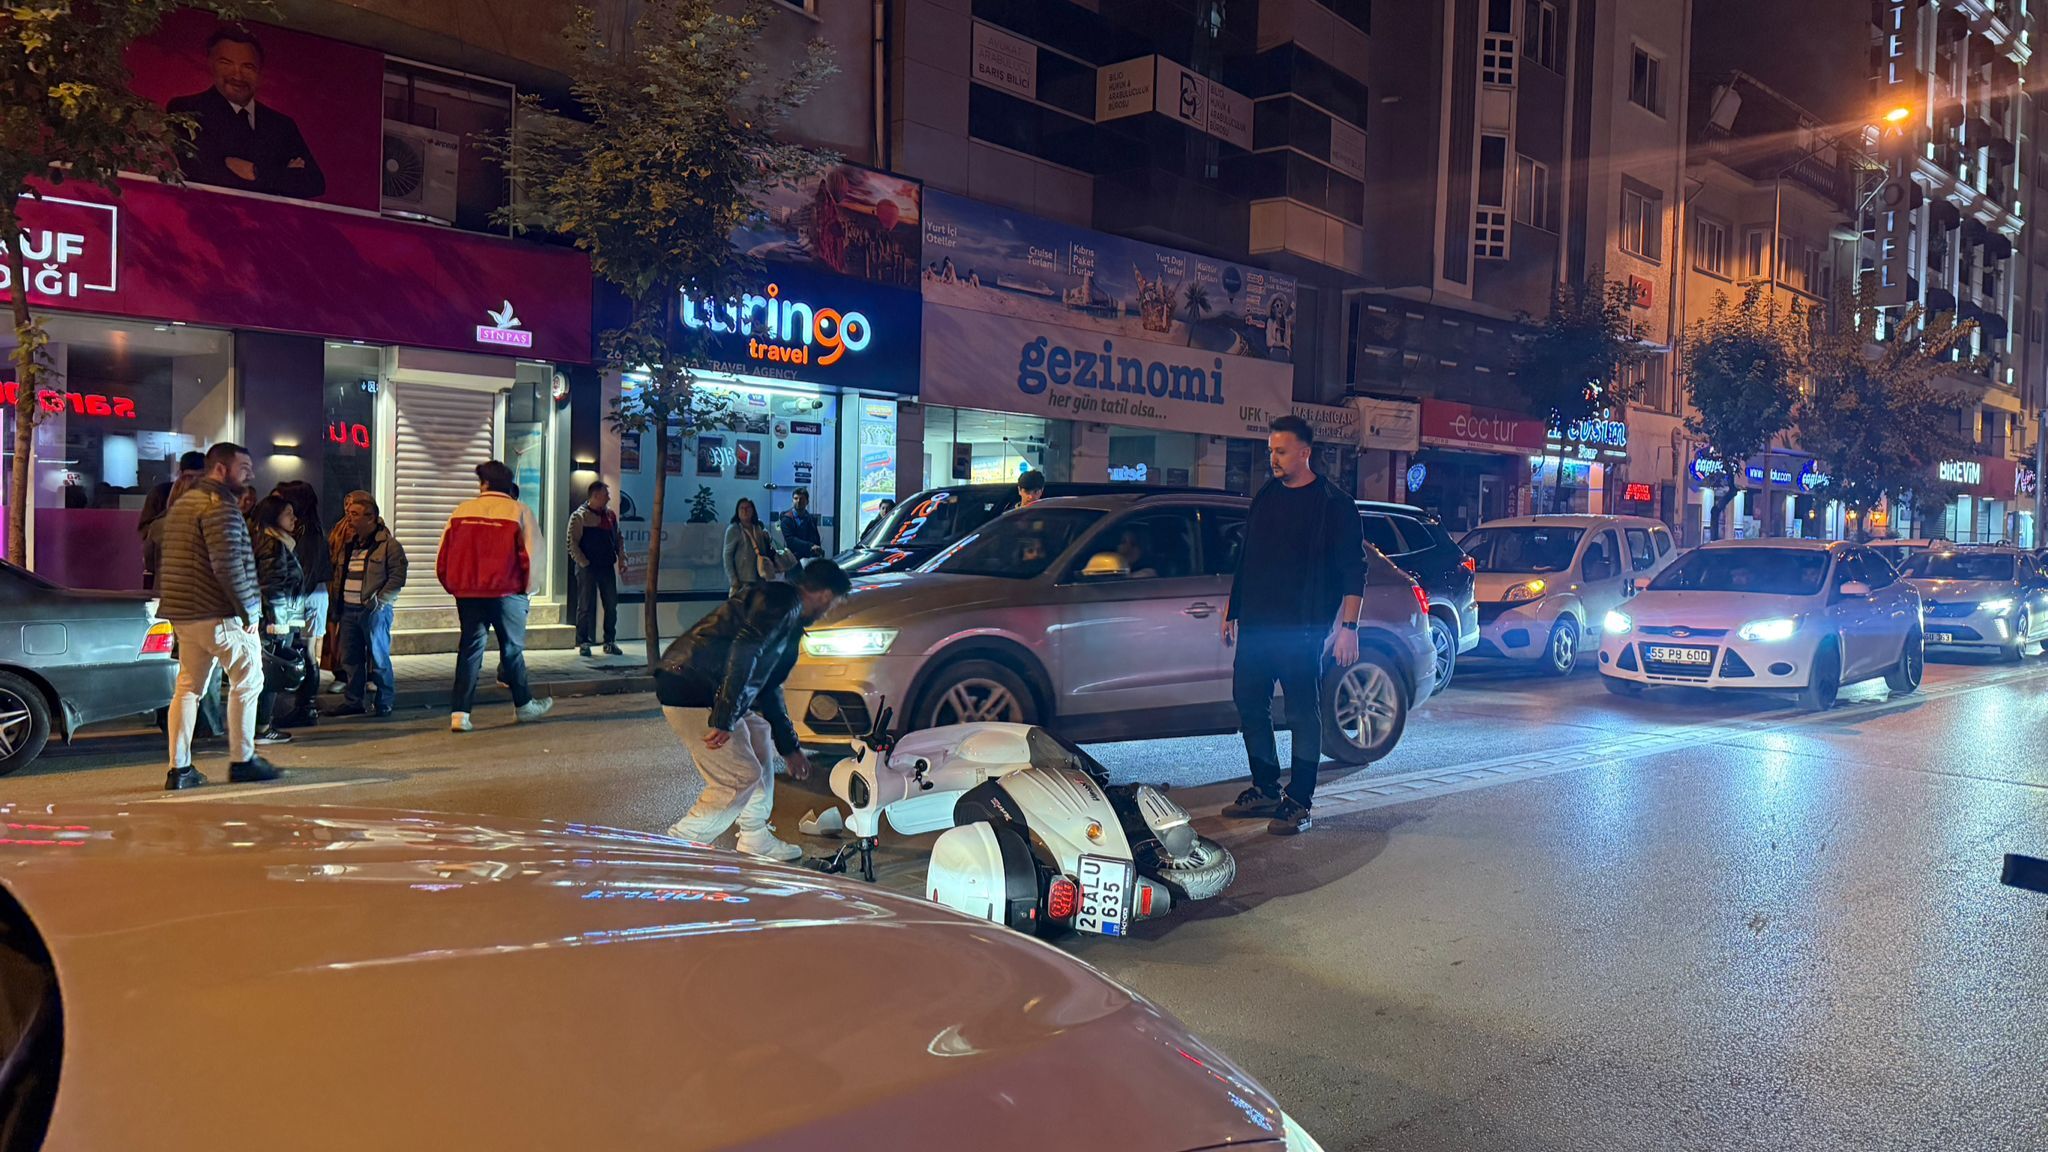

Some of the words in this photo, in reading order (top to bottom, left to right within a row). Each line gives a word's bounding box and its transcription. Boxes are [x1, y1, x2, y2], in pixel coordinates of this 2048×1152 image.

[1889, 0, 1905, 85] TEL
[926, 221, 946, 234] Yurt
[926, 233, 958, 248] Oteller
[1029, 246, 1053, 259] Cruise
[1073, 244, 1095, 257] Kıbrıs
[1073, 254, 1095, 268] Paket
[749, 338, 809, 365] travel
[752, 366, 798, 380] AGENCY
[1017, 335, 1225, 405] gezinomi
[1048, 389, 1070, 408] her
[1072, 394, 1098, 414] gün
[1101, 397, 1128, 415] tatil
[1240, 405, 1262, 422] UFK
[1508, 484, 1518, 519] KARG
[1651, 648, 1664, 658] 55
[1668, 648, 1682, 659] PB
[1686, 650, 1708, 661] 600
[1102, 882, 1120, 918] 635
